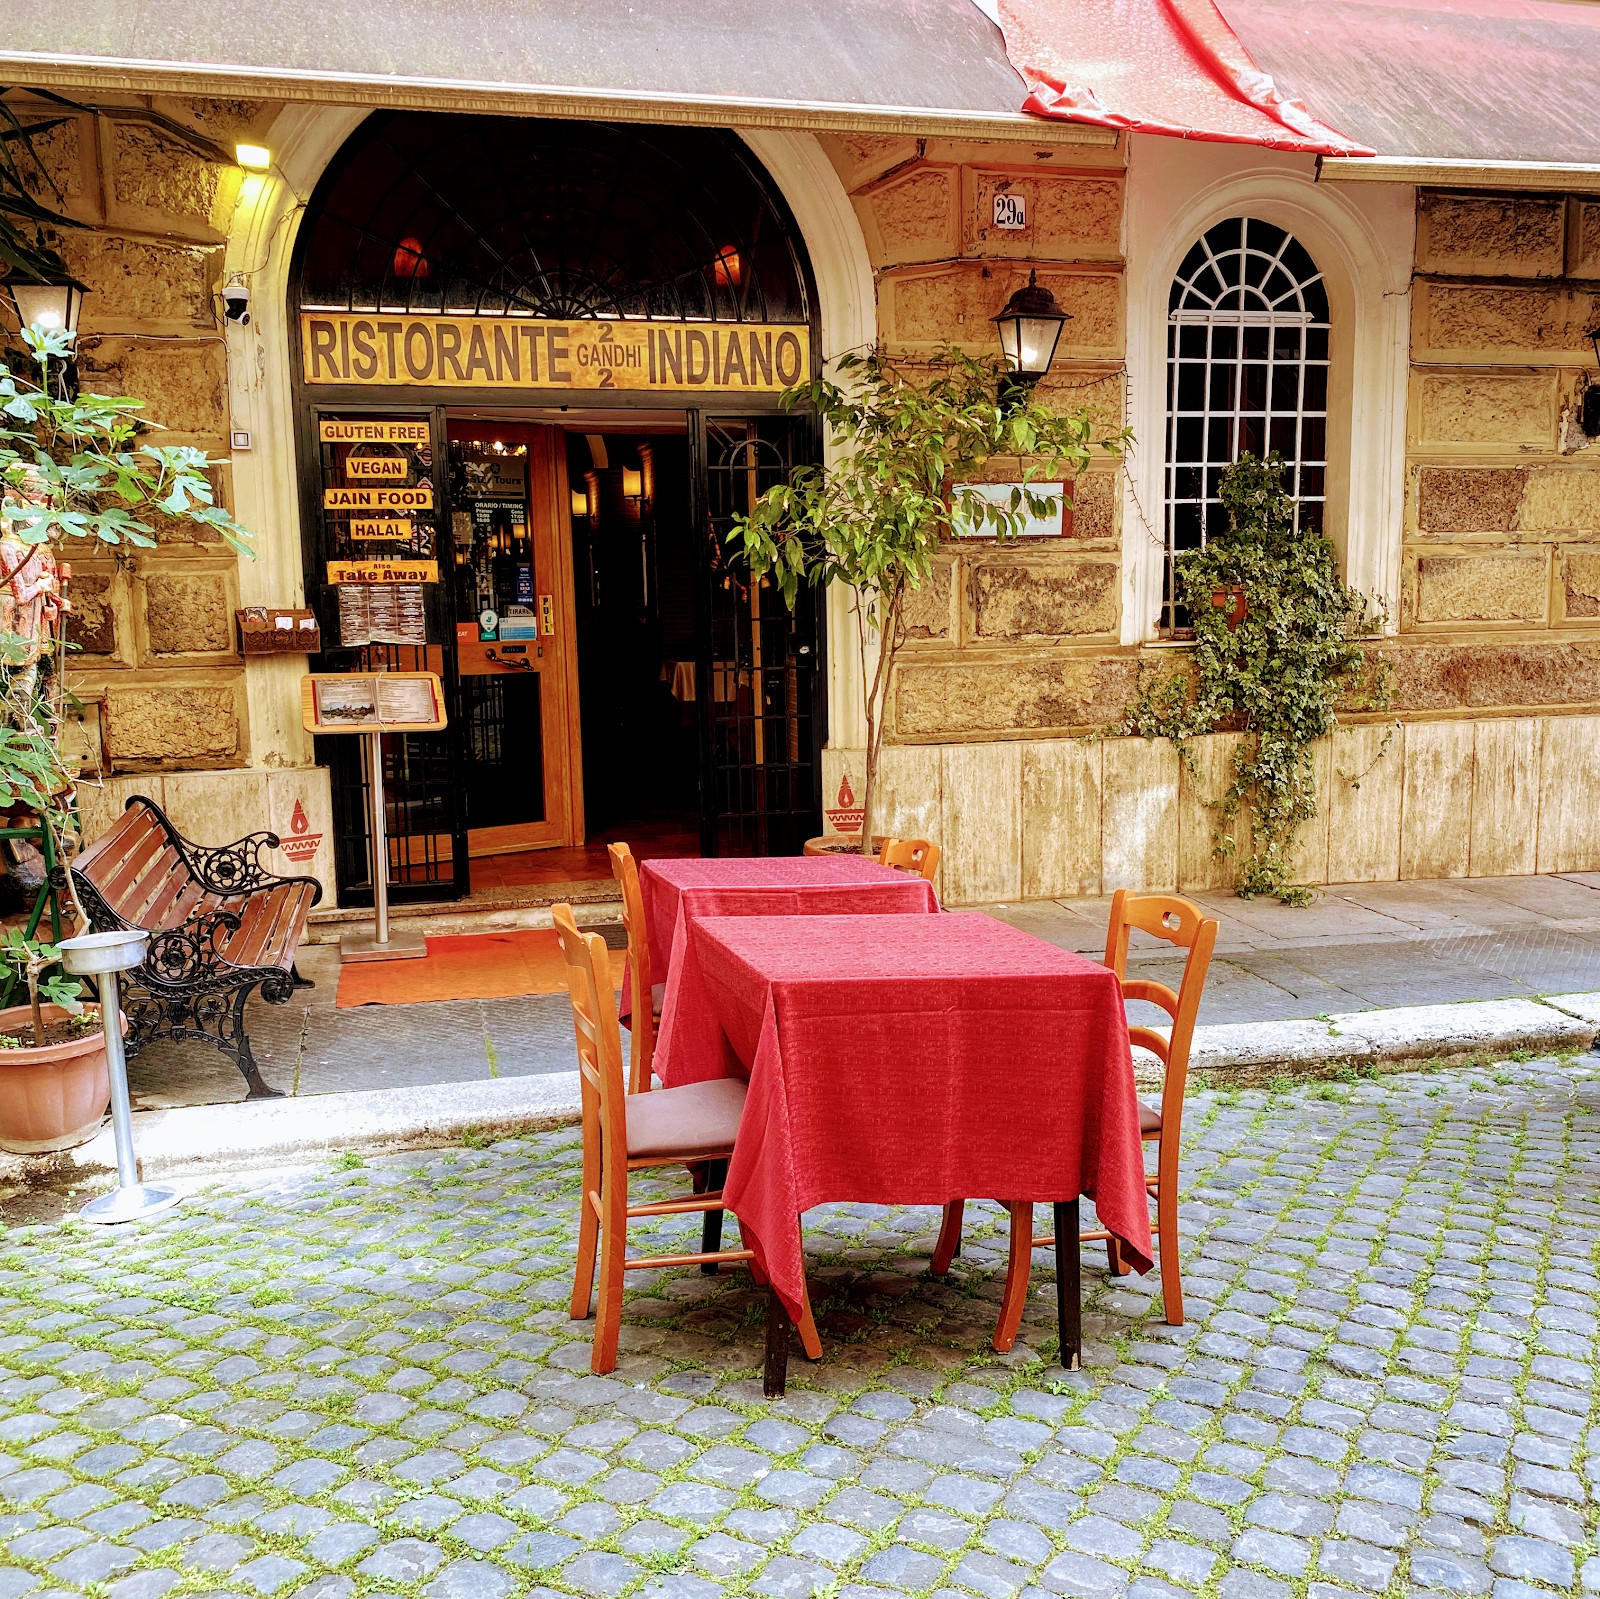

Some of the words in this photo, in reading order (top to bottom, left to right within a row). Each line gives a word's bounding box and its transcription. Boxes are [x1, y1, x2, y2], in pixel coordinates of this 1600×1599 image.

[996, 198, 1025, 225] 29a
[597, 323, 614, 343] 2
[310, 320, 571, 382] RISTORANTE
[576, 343, 642, 368] GANDHI
[647, 329, 802, 387] INDIANO
[599, 368, 615, 388] 2
[325, 426, 384, 439] GLUTEN
[389, 426, 426, 439] FREE
[351, 461, 402, 475] VEGAN
[494, 475, 523, 485] Tours
[328, 492, 371, 505] JAIN
[377, 492, 427, 505] FOOD
[356, 524, 403, 536] HALAL
[337, 570, 378, 581] Take
[382, 569, 428, 581] Away
[542, 597, 550, 633] PULL
